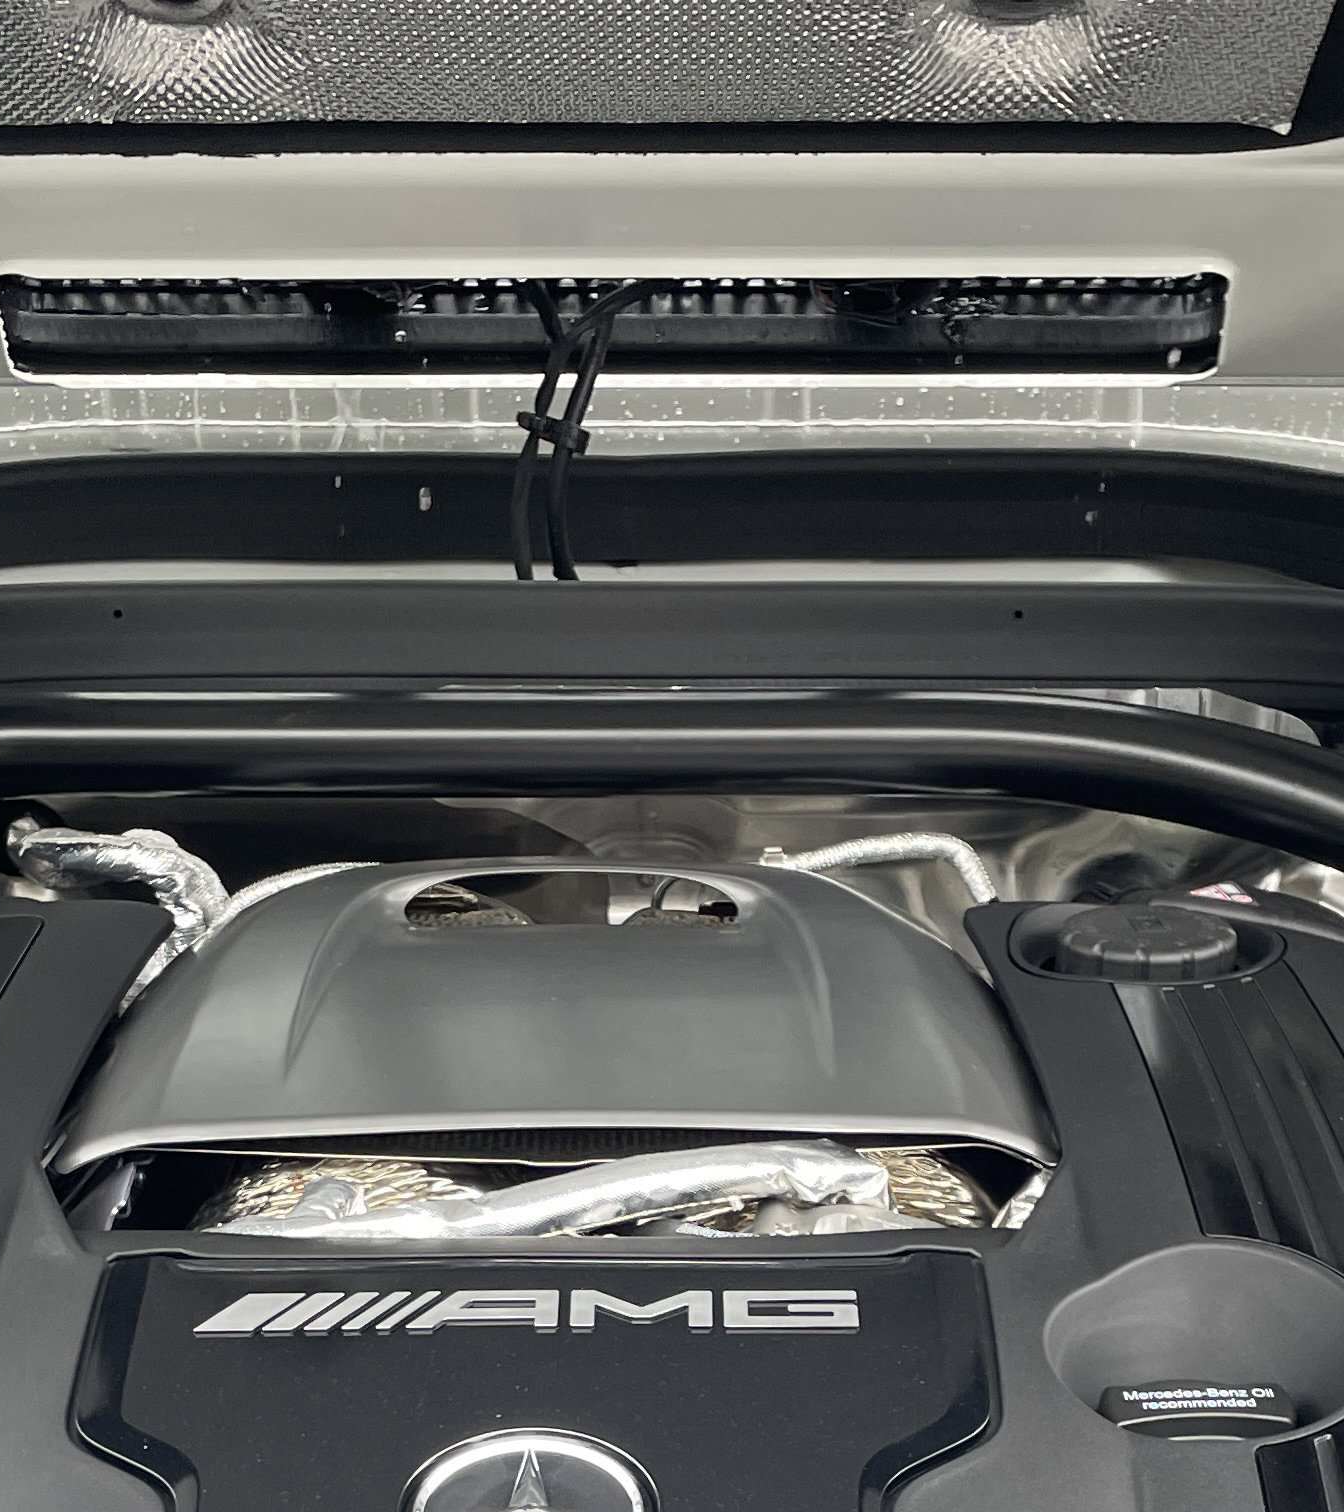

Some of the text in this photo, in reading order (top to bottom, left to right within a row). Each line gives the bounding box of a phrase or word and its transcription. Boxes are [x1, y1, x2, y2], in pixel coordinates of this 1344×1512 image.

[405, 1289, 861, 1334] AMG
[1122, 1387, 1275, 1401] Mercedes-Benz Oil
[1142, 1397, 1257, 1410] recommended
